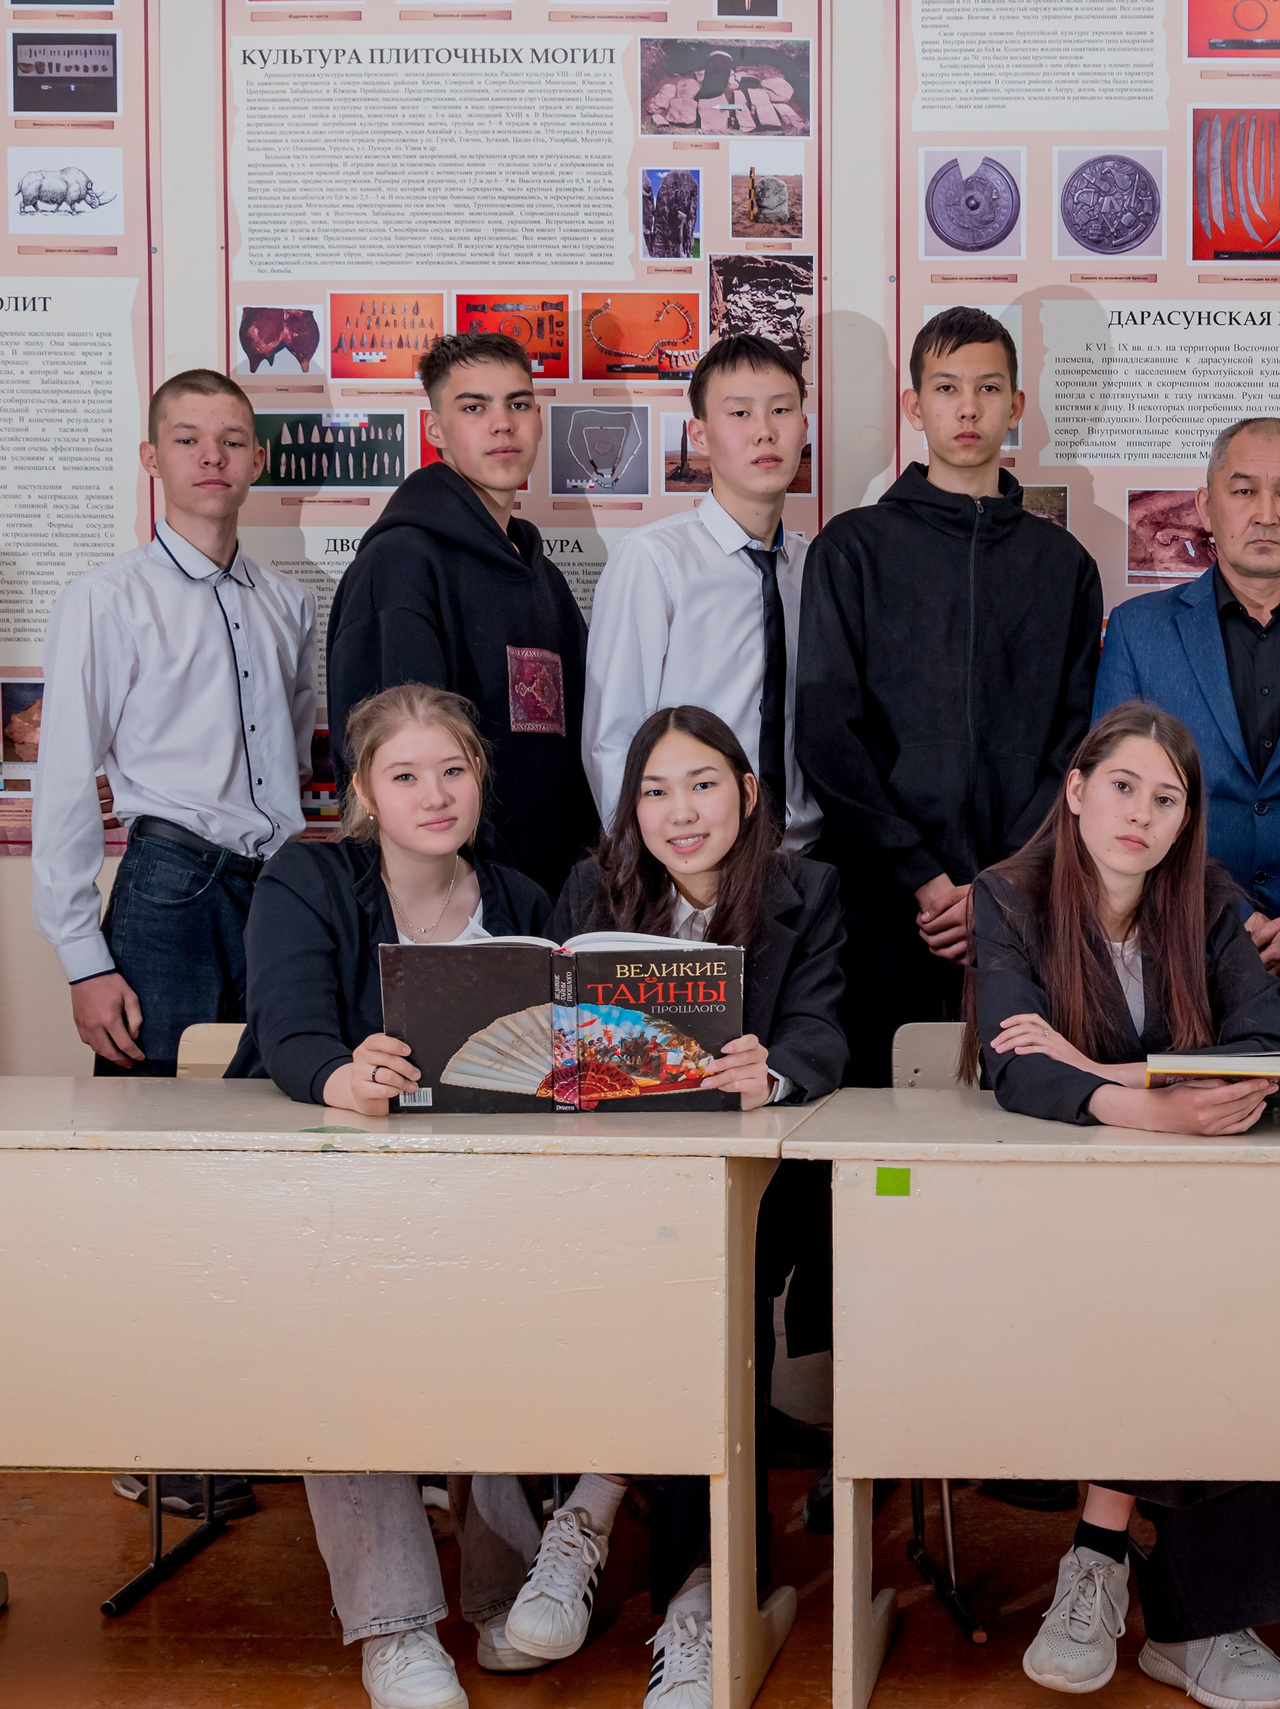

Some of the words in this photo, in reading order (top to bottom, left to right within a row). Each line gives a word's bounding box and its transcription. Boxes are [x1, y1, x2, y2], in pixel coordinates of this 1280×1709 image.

[241, 48, 363, 69] КУЛЬТУРА
[368, 48, 524, 65] ПЛИТОЧНЫХ
[530, 47, 616, 65] МОГИЛ
[1108, 310, 1272, 330] ДАРАСУНСКАЯ
[1179, 345, 1230, 354] территории
[1055, 357, 1094, 366] племена,
[1101, 357, 1178, 366] принадлежавшие
[1198, 355, 1253, 366] дарасунской
[1055, 369, 1118, 377] одновременно
[1191, 367, 1253, 378] бурхотуйской
[1055, 381, 1097, 389] хоронили
[1102, 381, 1141, 389] умерших
[1156, 381, 1209, 390] скорченном
[1055, 393, 1085, 401] иногда
[1099, 393, 1159, 401] подтянутыми
[1175, 393, 1192, 401] тазу
[1241, 391, 1263, 402] Руки
[1101, 405, 1125, 413] лицу.
[1137, 405, 1185, 413] некоторых
[1188, 402, 1243, 413] погребениях
[1245, 405, 1261, 413] под
[1055, 414, 1141, 425] плитки-«подушки».
[1145, 414, 1204, 425] Погребенные
[1055, 429, 1080, 437] север.
[1087, 426, 1169, 437] Внутримогильные
[1055, 438, 1116, 449] погребальном
[1126, 441, 1172, 449] инвентаре
[1055, 453, 1121, 461] тюркоязычных
[1123, 453, 1149, 461] групп
[616, 962, 727, 978] ВЕЛИКИЕ
[587, 977, 727, 1005] ТАЙНЫ
[651, 1004, 726, 1014] ПРОШЛОГО
